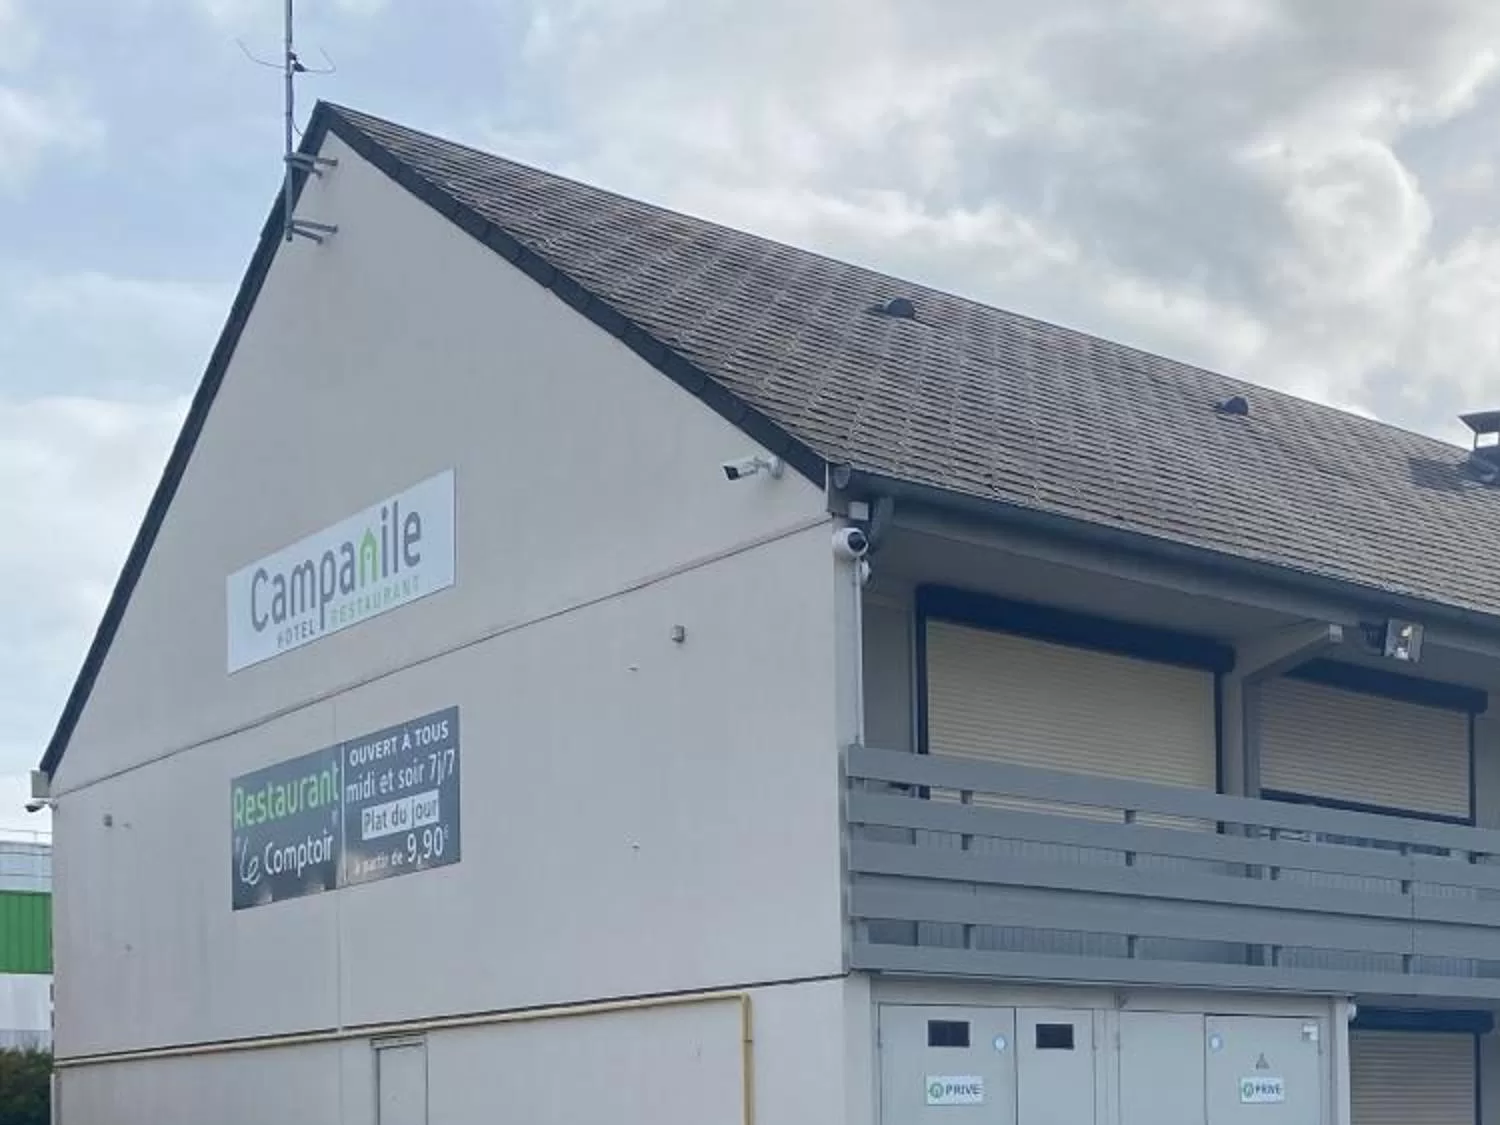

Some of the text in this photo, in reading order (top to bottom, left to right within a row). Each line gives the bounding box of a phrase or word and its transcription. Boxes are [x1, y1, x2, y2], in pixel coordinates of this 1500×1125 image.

[251, 500, 422, 633] Campanile
[277, 575, 420, 648] HOTEL RESTAURANT
[350, 736, 398, 767] OUVERT
[415, 720, 449, 747] TOUS
[233, 760, 340, 830] Restaurant
[346, 748, 455, 803] midi et soir 7j/7
[364, 809, 388, 833] Plat
[391, 803, 408, 826] du
[264, 826, 334, 877] Comptoir
